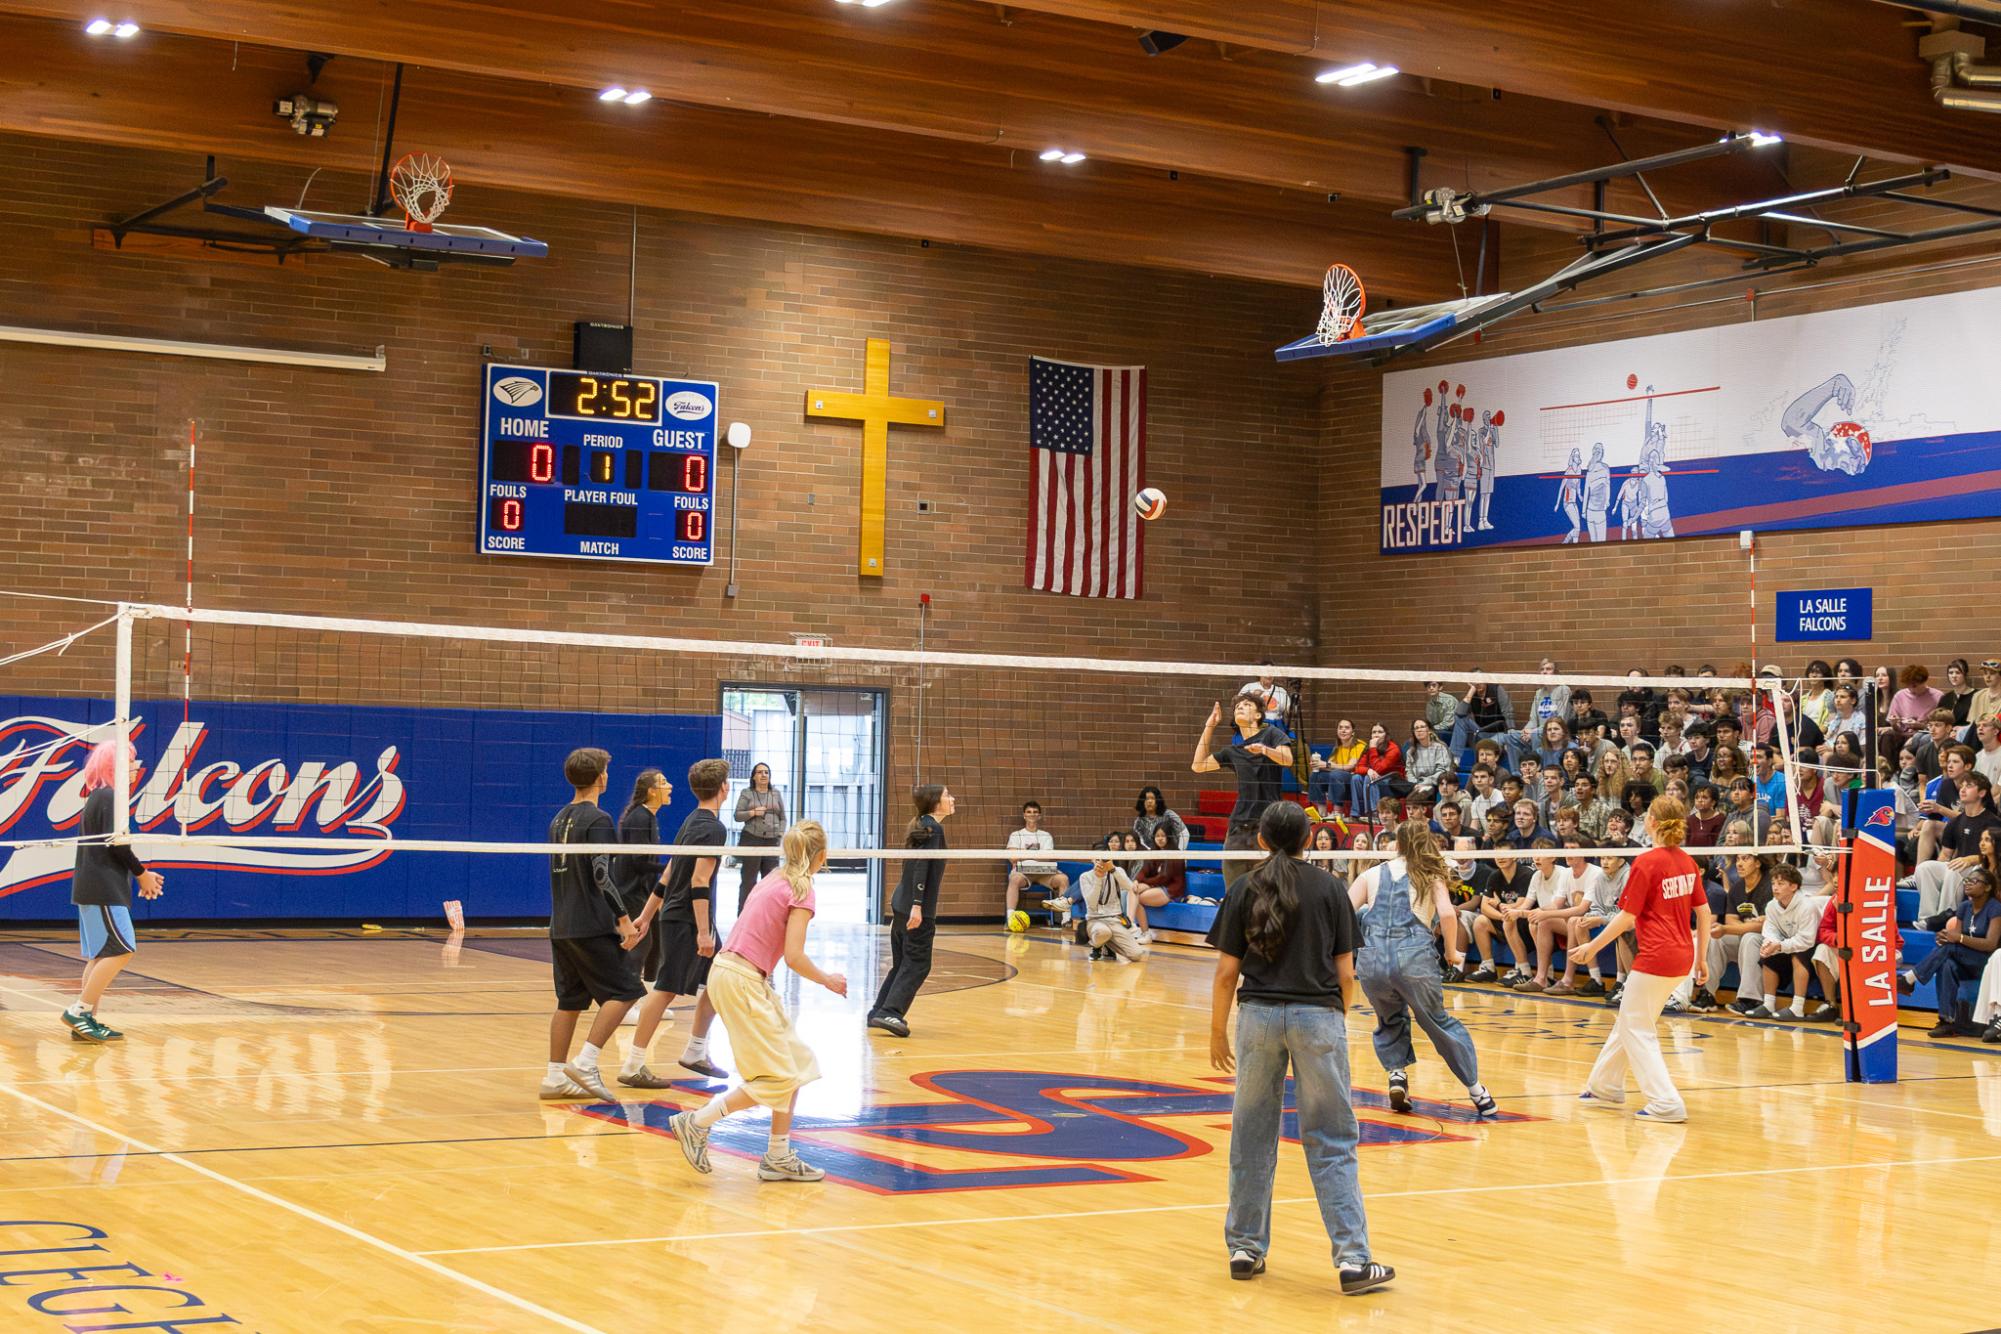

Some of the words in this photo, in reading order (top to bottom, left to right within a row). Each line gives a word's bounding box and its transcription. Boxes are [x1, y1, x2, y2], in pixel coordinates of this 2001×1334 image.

[577, 377, 656, 419] 2:52
[500, 418, 549, 438] HOME
[583, 434, 623, 449] PERIOD
[653, 429, 705, 450] GUEST
[531, 444, 552, 482] 0
[604, 455, 611, 480] 1
[685, 456, 705, 491] 0
[490, 484, 527, 498] FOULS
[564, 489, 607, 504] PLAYER
[610, 492, 638, 506] FOUL
[674, 497, 709, 510] FOULS
[503, 500, 520, 529] 0
[1383, 499, 1466, 548] RESPECT
[687, 511, 703, 540] 0
[488, 536, 525, 550] SCORE
[580, 541, 619, 555] MATCH
[672, 546, 708, 560] SCORE
[1799, 599, 1813, 614] LA
[1815, 598, 1847, 613] SALLE
[1799, 616, 1847, 632] FALCONS
[1861, 876, 1892, 964] SALLE
[1864, 971, 1894, 1007] LA
